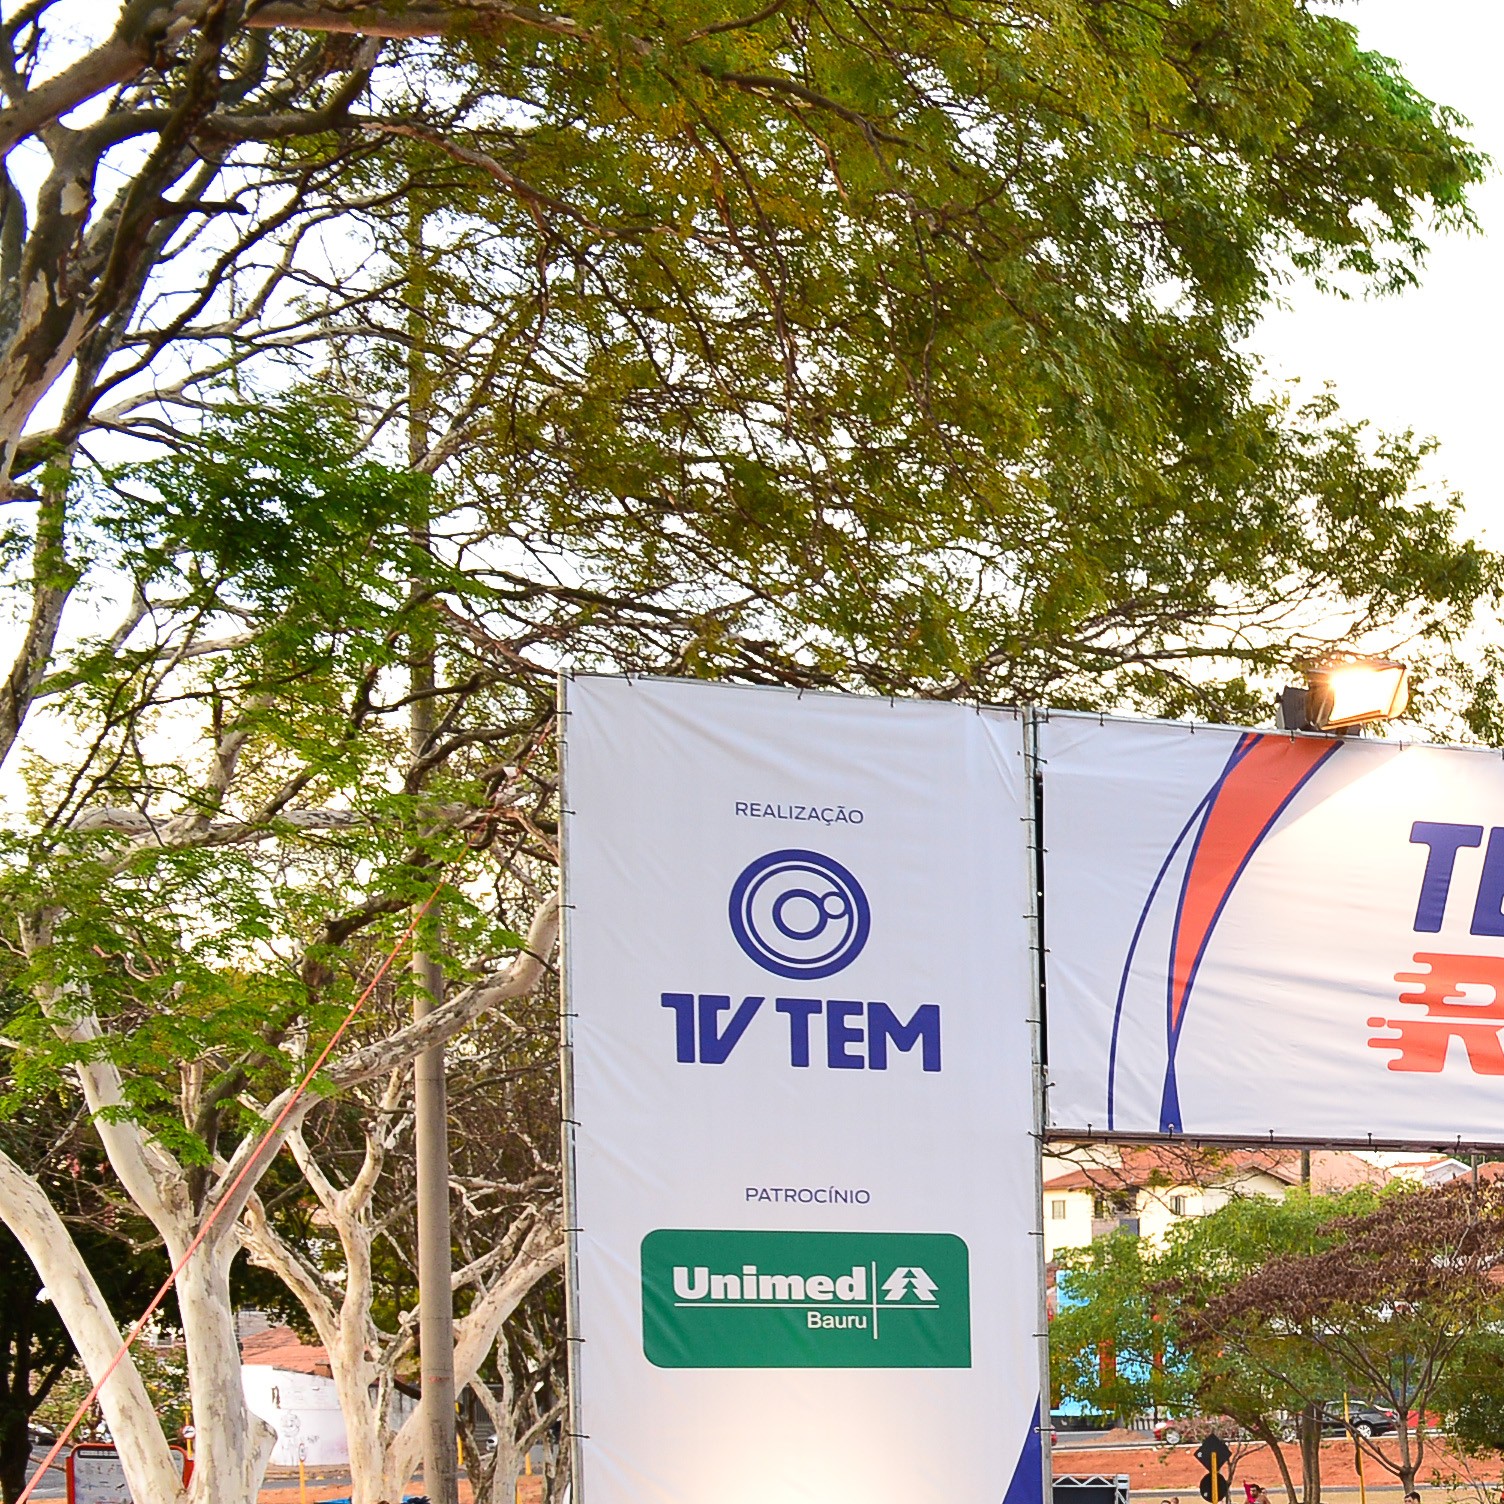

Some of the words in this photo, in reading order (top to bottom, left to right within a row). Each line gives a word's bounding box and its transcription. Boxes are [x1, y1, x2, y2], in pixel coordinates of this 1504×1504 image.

[735, 801, 864, 826] REALIZAÇÃO
[660, 992, 766, 1065] TV
[775, 997, 942, 1073] TEM
[745, 1184, 871, 1206] PATROCÍNIO
[672, 1264, 867, 1302] Unimed
[807, 1310, 868, 1331] Bauru
